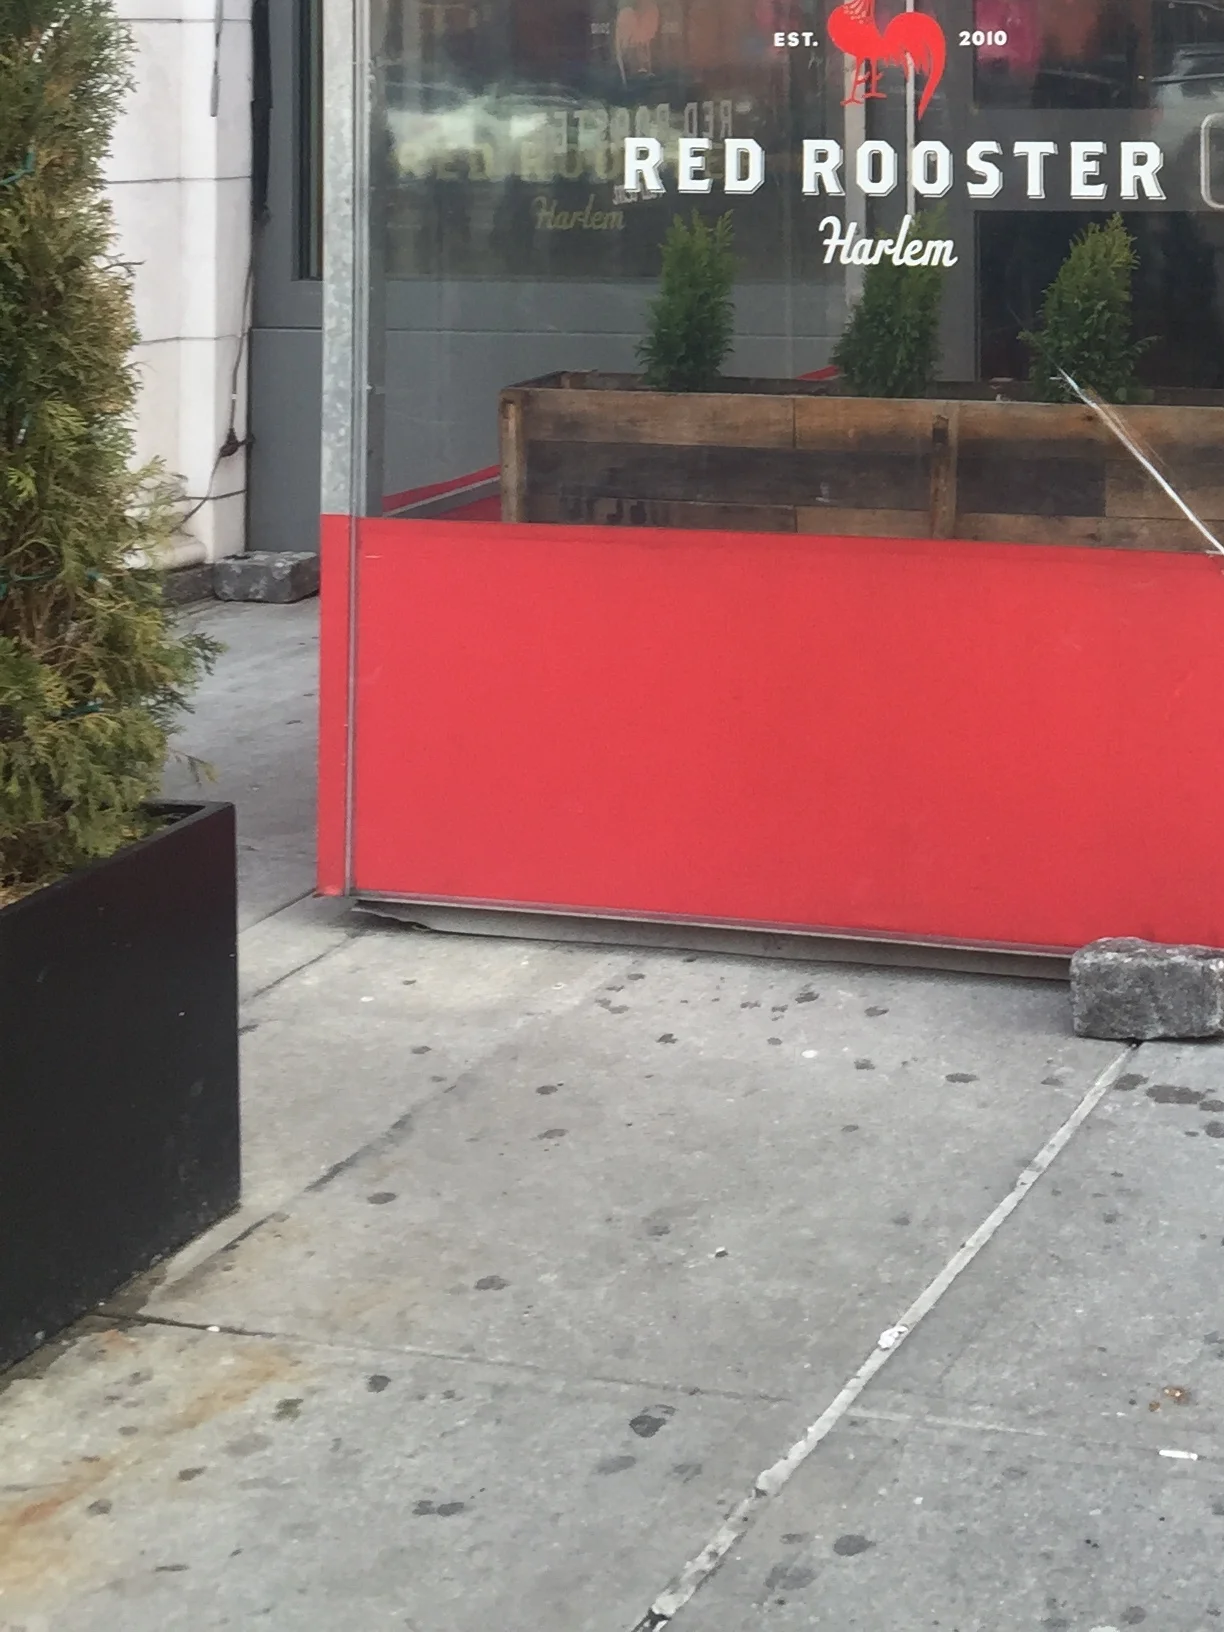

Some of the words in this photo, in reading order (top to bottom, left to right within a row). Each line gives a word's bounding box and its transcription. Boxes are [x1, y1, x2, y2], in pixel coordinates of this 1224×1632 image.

[774, 31, 819, 47] EST.
[958, 30, 1008, 47] 2010
[623, 137, 765, 195] RED
[801, 139, 1168, 200] ROOSTER
[818, 214, 960, 267] Harlem
